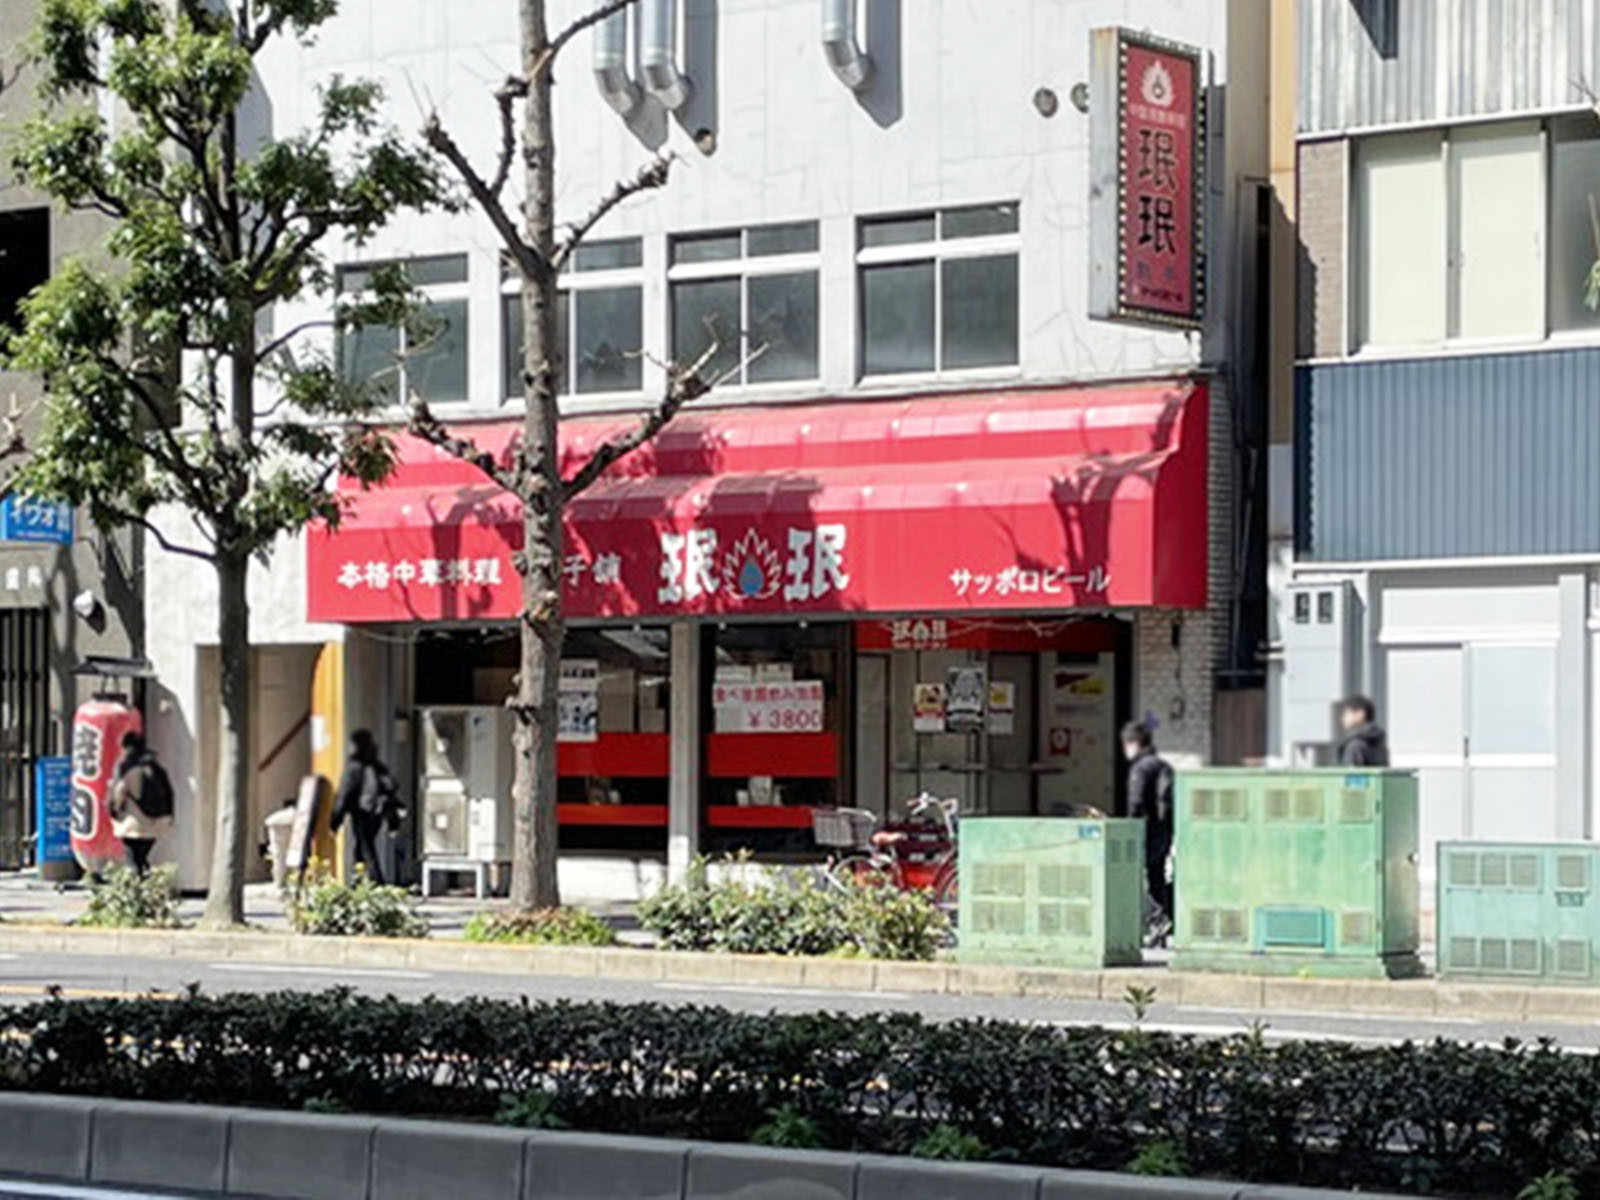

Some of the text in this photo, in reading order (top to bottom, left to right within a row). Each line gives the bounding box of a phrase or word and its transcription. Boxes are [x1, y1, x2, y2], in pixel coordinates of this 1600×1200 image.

[950, 565, 1111, 596] サッポロビール
